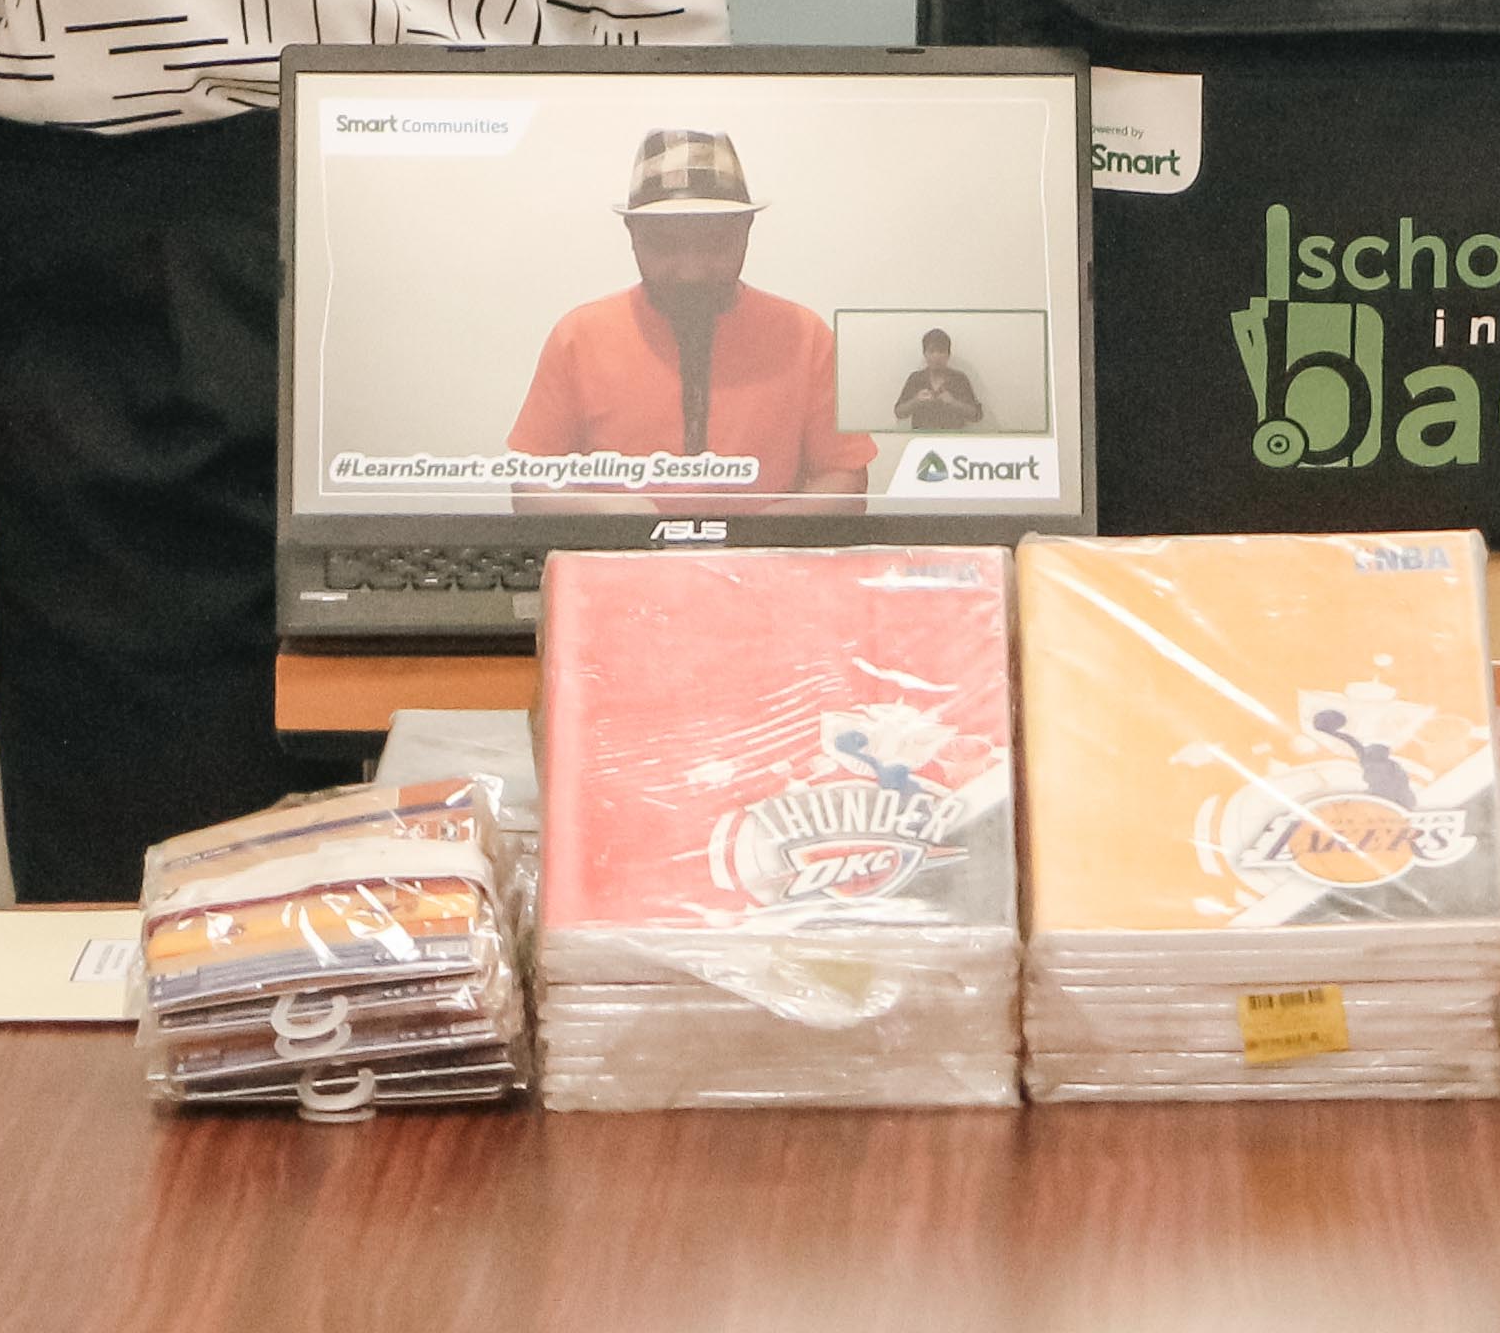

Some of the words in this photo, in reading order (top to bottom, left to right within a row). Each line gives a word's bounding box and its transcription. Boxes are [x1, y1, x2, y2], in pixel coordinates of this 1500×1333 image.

[336, 114, 398, 133] Smart
[402, 118, 509, 134] Communities
[1092, 143, 1181, 176] Smart
[1434, 308, 1497, 348] in
[336, 458, 485, 478] #LearnSmart:
[491, 458, 646, 482] eStorytelling
[652, 458, 753, 478] Sessions
[952, 455, 1040, 481] Smart
[650, 520, 728, 541] ASUS
[744, 785, 966, 846] THUNDER
